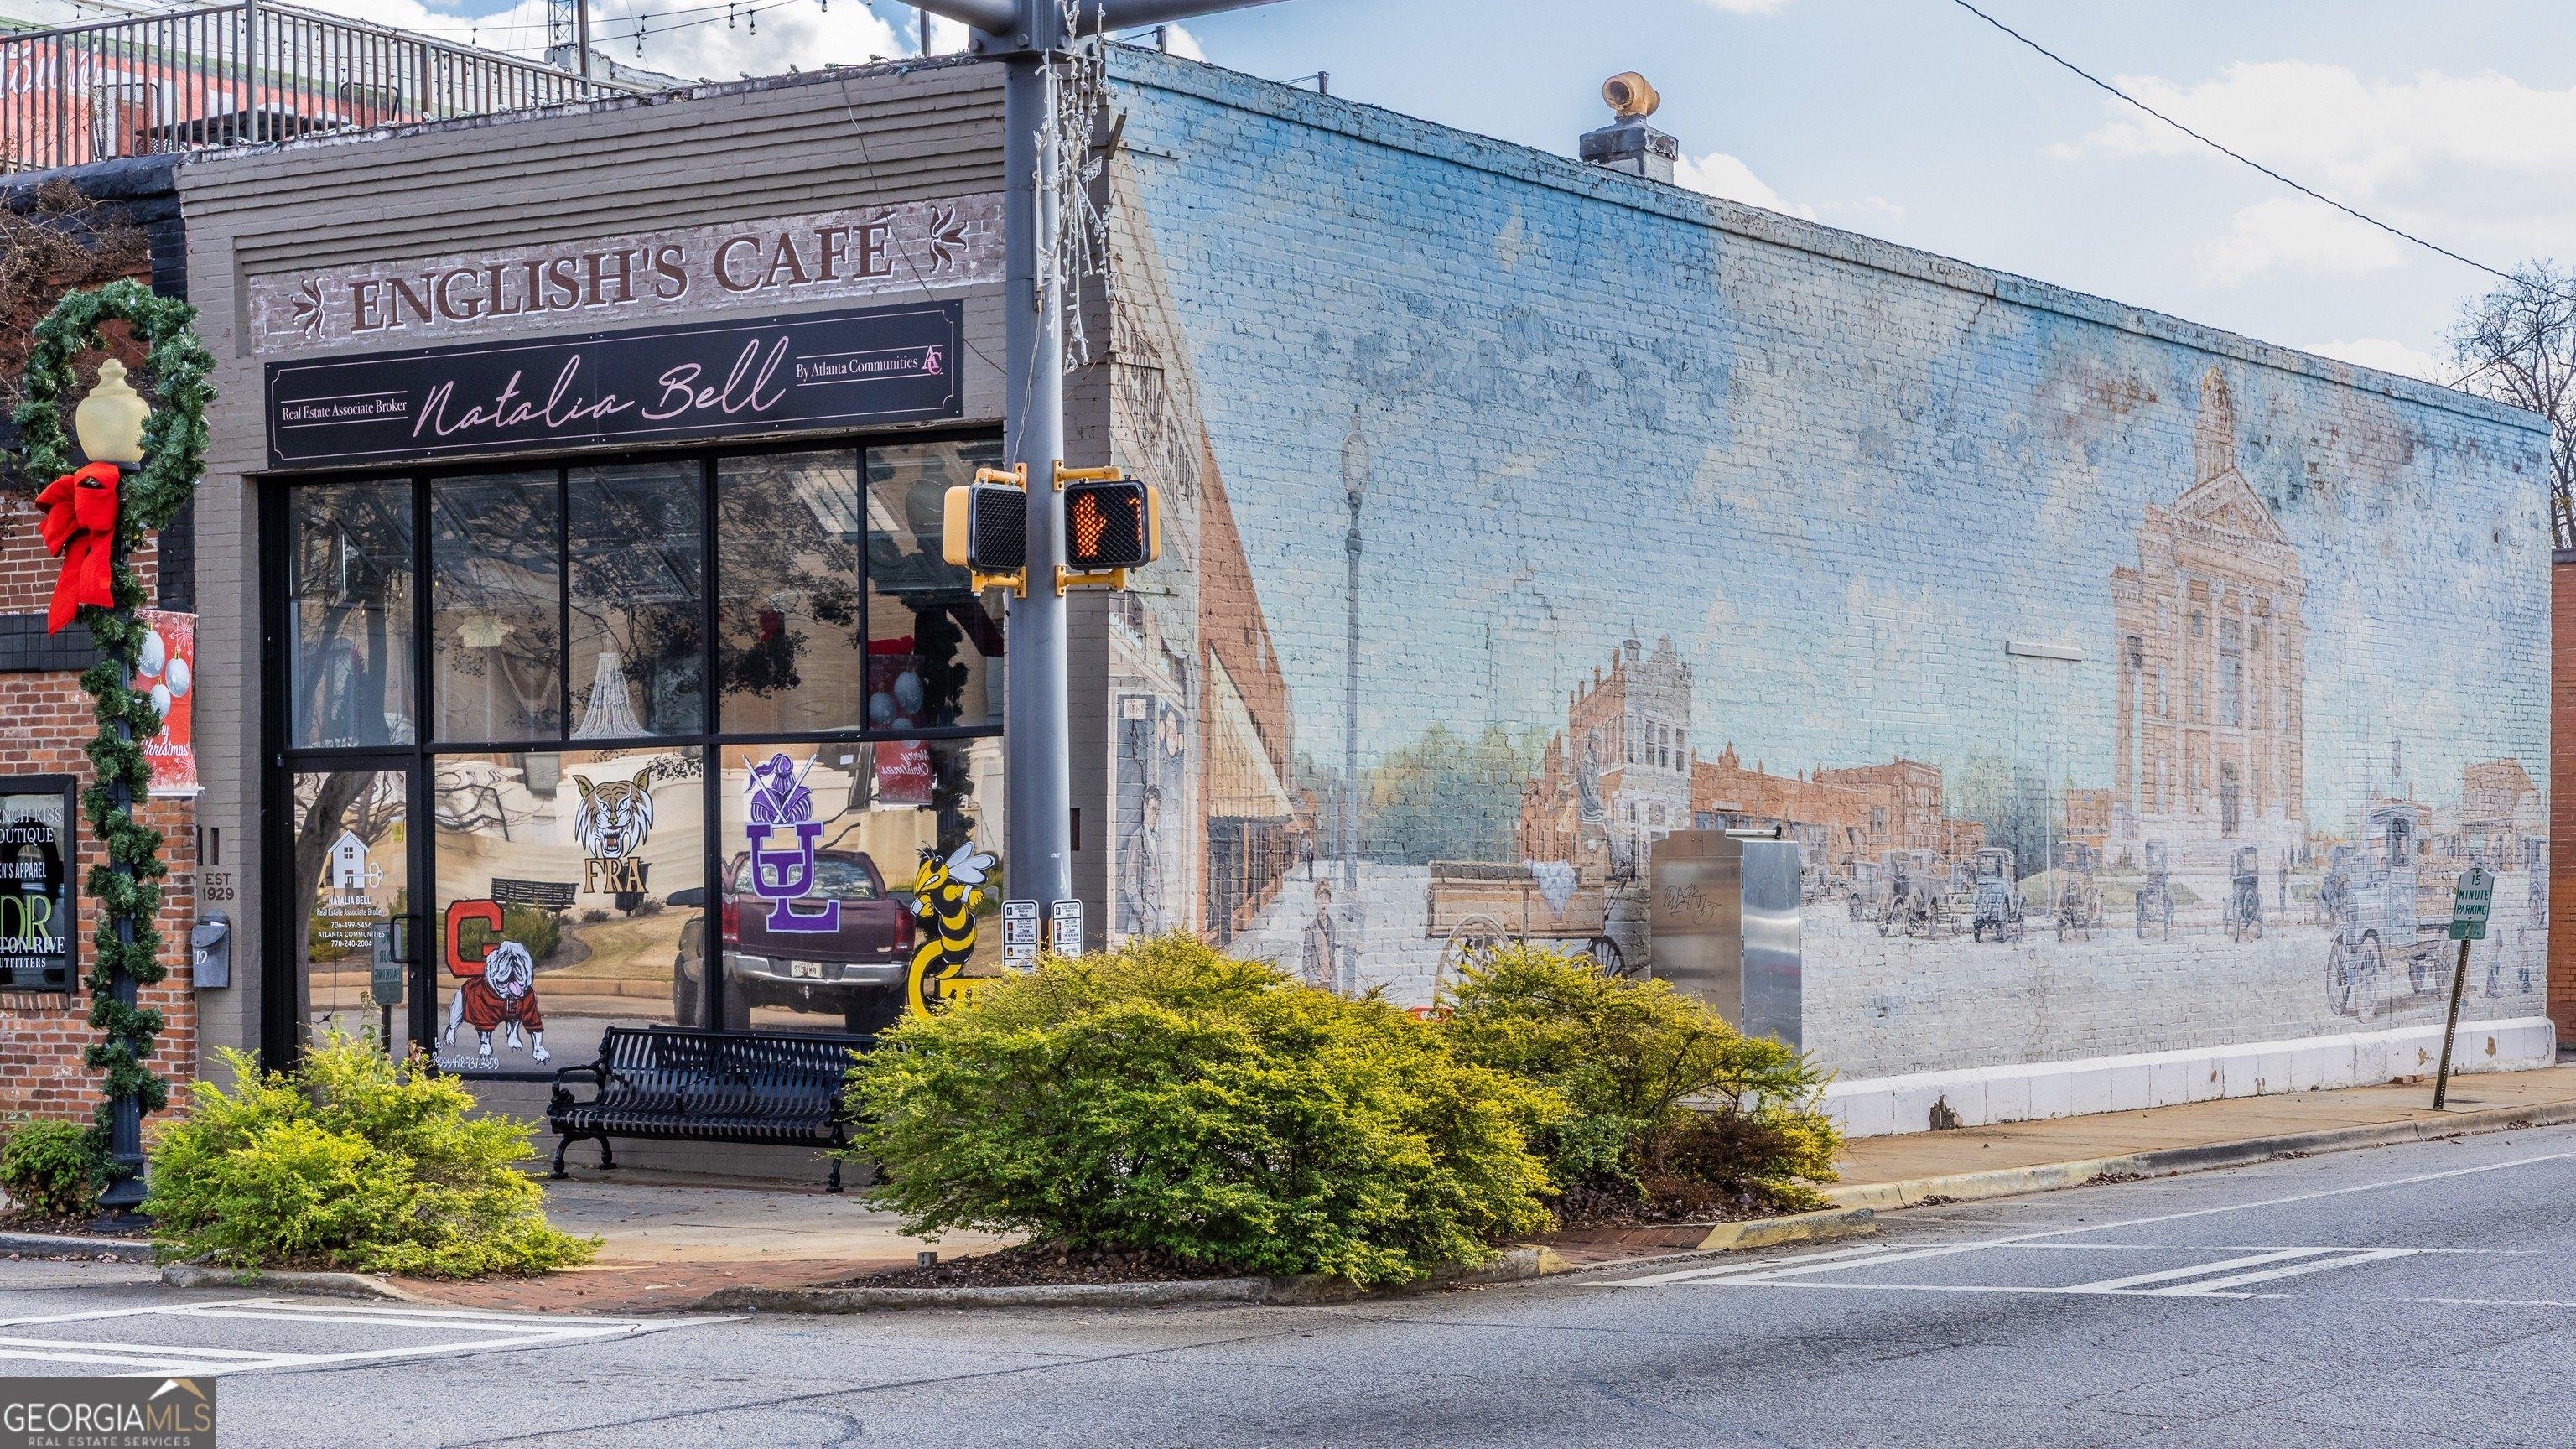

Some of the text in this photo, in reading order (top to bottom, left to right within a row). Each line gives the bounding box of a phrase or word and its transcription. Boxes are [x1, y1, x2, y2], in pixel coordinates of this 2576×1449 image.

[348, 210, 896, 334] ENGLISH'S CAFÉ
[797, 363, 809, 382] By
[811, 361, 847, 377] Atlanta
[849, 356, 919, 374] Communities
[413, 335, 789, 437] Natalia Bell
[282, 397, 408, 421] Real Estate Associate Broker
[0, 808, 62, 823] NCH KISS
[0, 861, 47, 879] N'S APPAREL
[583, 856, 649, 894] FRA
[205, 873, 232, 886] EST.
[2471, 875, 2482, 886] 15
[202, 887, 235, 901] 1929
[328, 896, 371, 905] NATALIA BELL
[2458, 889, 2490, 901] MINUTE
[344, 908, 366, 917] Associate
[367, 908, 384, 917] Broker
[2455, 904, 2488, 916] PARKING
[330, 921, 372, 929] 706-499-5456
